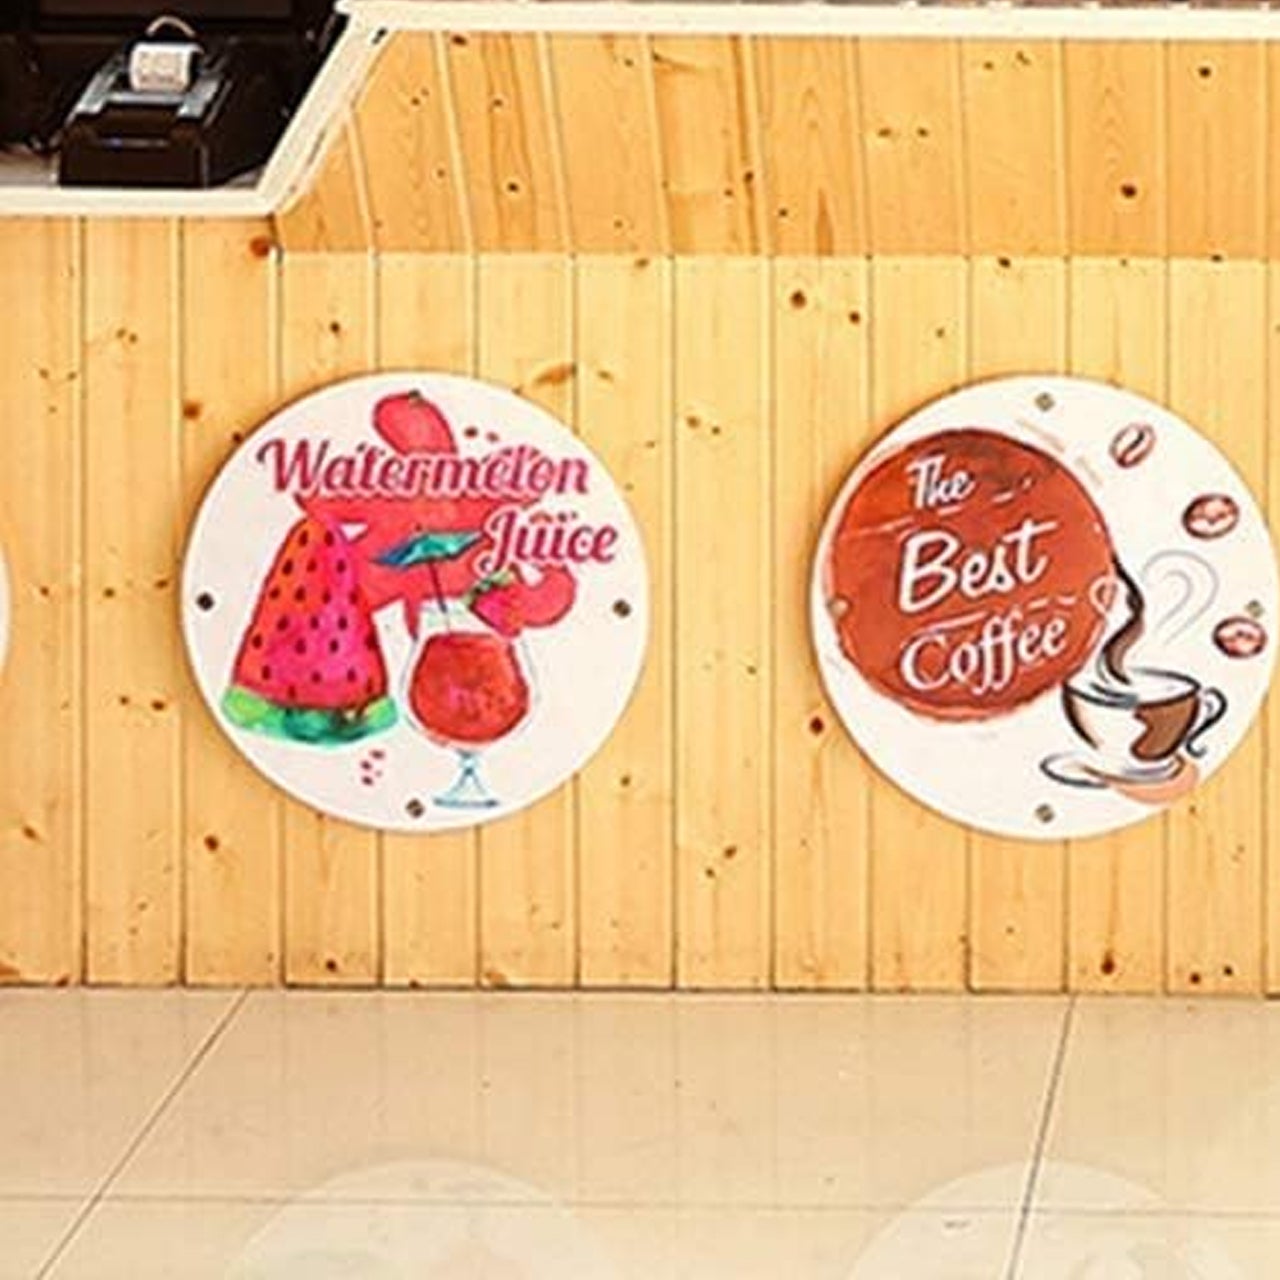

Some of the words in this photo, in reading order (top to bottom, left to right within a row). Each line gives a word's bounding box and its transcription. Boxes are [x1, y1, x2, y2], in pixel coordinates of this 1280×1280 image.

[256, 439, 591, 496] Watermelon
[907, 454, 975, 509] The
[480, 509, 618, 573] Juice
[900, 519, 1058, 613] Best
[901, 607, 1067, 694] Coffee
